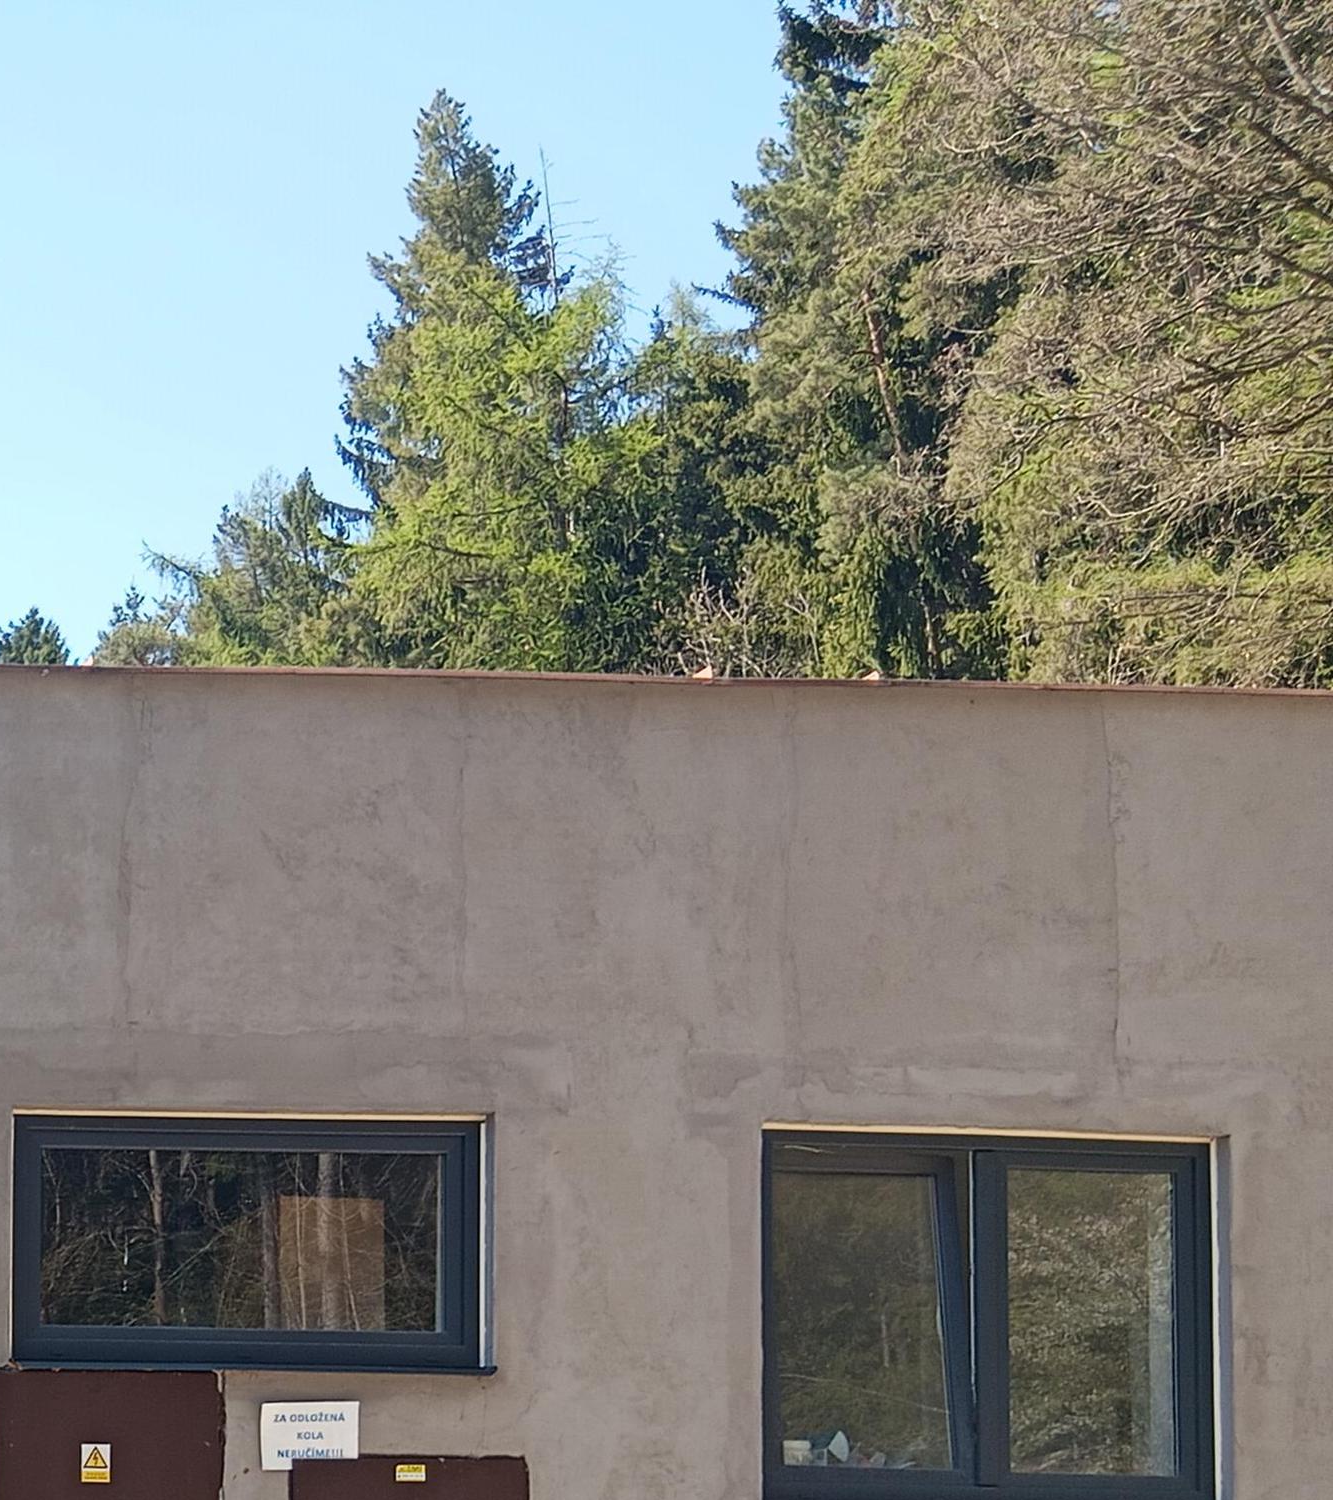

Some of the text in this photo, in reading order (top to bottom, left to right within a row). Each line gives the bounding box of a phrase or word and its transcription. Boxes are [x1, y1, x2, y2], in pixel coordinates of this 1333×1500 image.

[273, 1411, 346, 1423] ZA ODLOŽENÁ
[296, 1431, 324, 1441] KOLA
